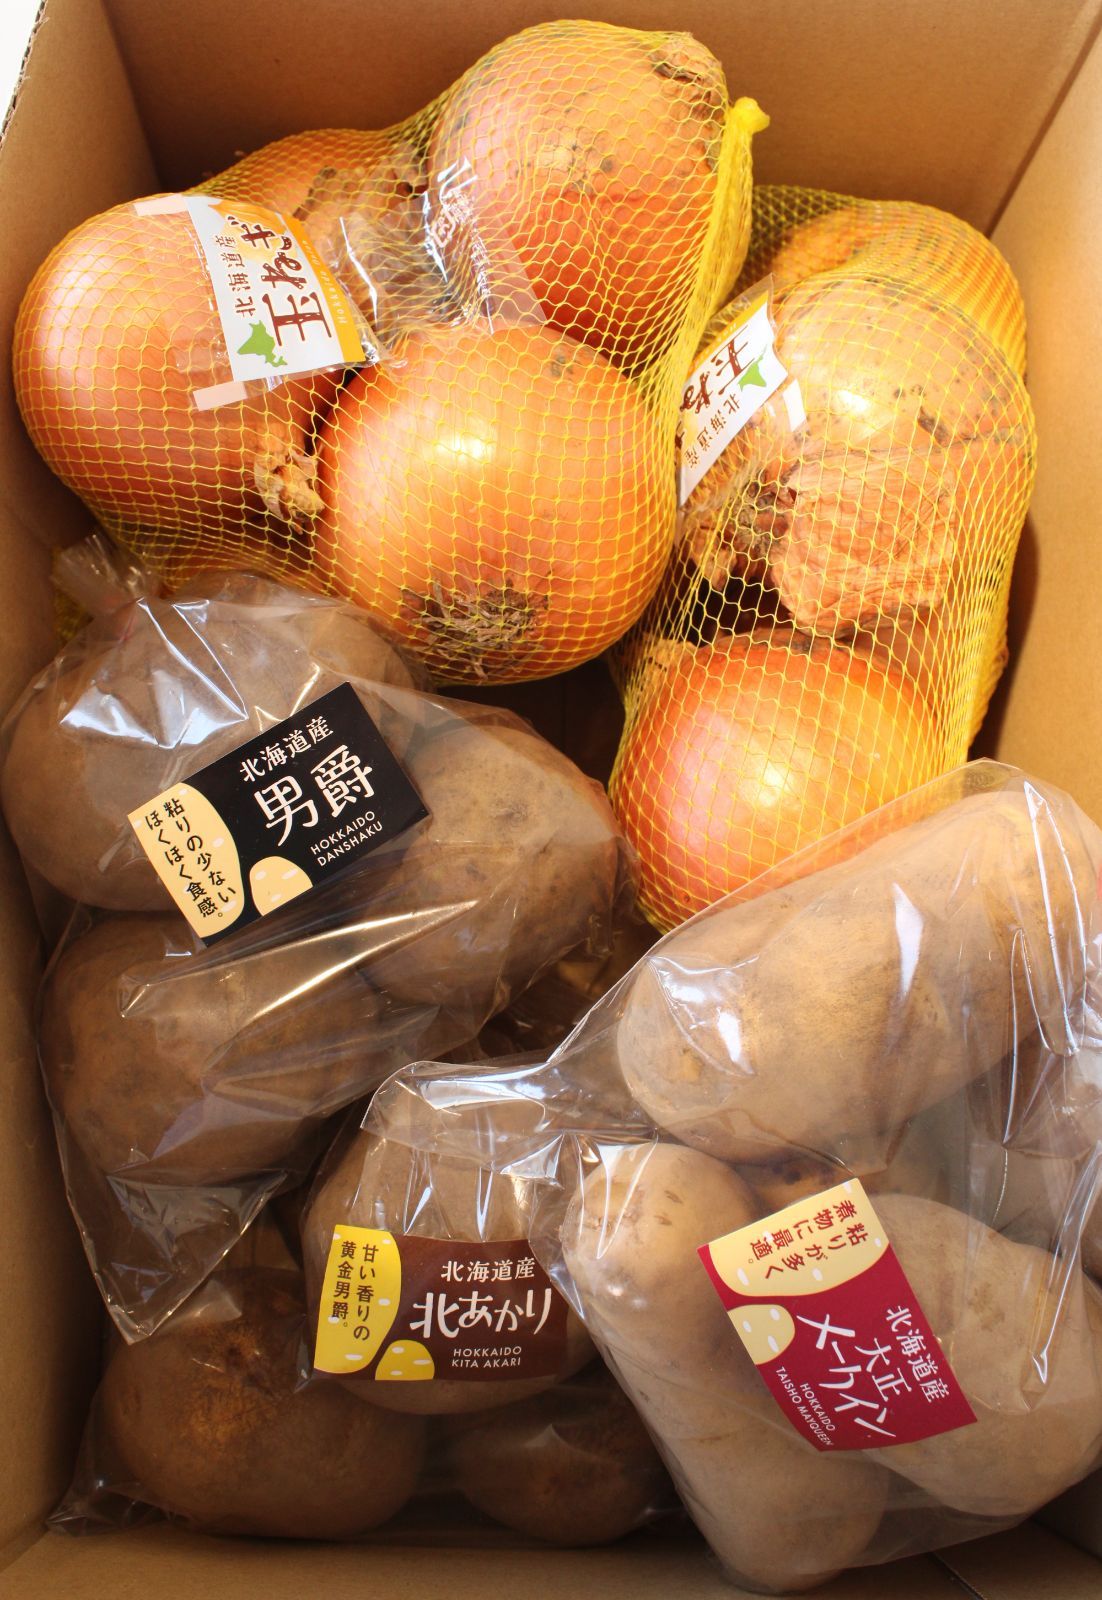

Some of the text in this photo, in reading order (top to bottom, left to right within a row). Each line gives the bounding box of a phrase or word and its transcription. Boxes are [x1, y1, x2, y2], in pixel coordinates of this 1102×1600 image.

[215, 235, 256, 318] 北海道産
[227, 215, 332, 347] 玉ねぎ
[685, 393, 741, 469] 北海道産
[239, 715, 334, 783] 北海道産
[253, 744, 374, 848] 男爵
[144, 810, 224, 918] ほくほく食感。
[163, 798, 236, 904] 粘りの少ない
[310, 810, 376, 856] HOKKAIDO
[317, 820, 384, 867] DANSHAKU
[747, 1199, 858, 1265] 煮物に最適。
[764, 1222, 870, 1280] 粘りが多く
[331, 1240, 357, 1328] 黄金男爵。
[353, 1243, 379, 1342] 甘い香りの
[440, 1256, 536, 1284] 北海道産
[409, 1287, 552, 1340] 北あかり
[452, 1356, 522, 1369] KITA AKARI
[453, 1345, 523, 1358] HOKKAIDO
[796, 1313, 897, 1438] メークイン
[854, 1337, 913, 1402] 大正
[885, 1305, 951, 1403] 北海道産
[775, 1366, 834, 1447] TAISHO MAYQUEEN
[799, 1382, 836, 1432] HOKKAIDO
